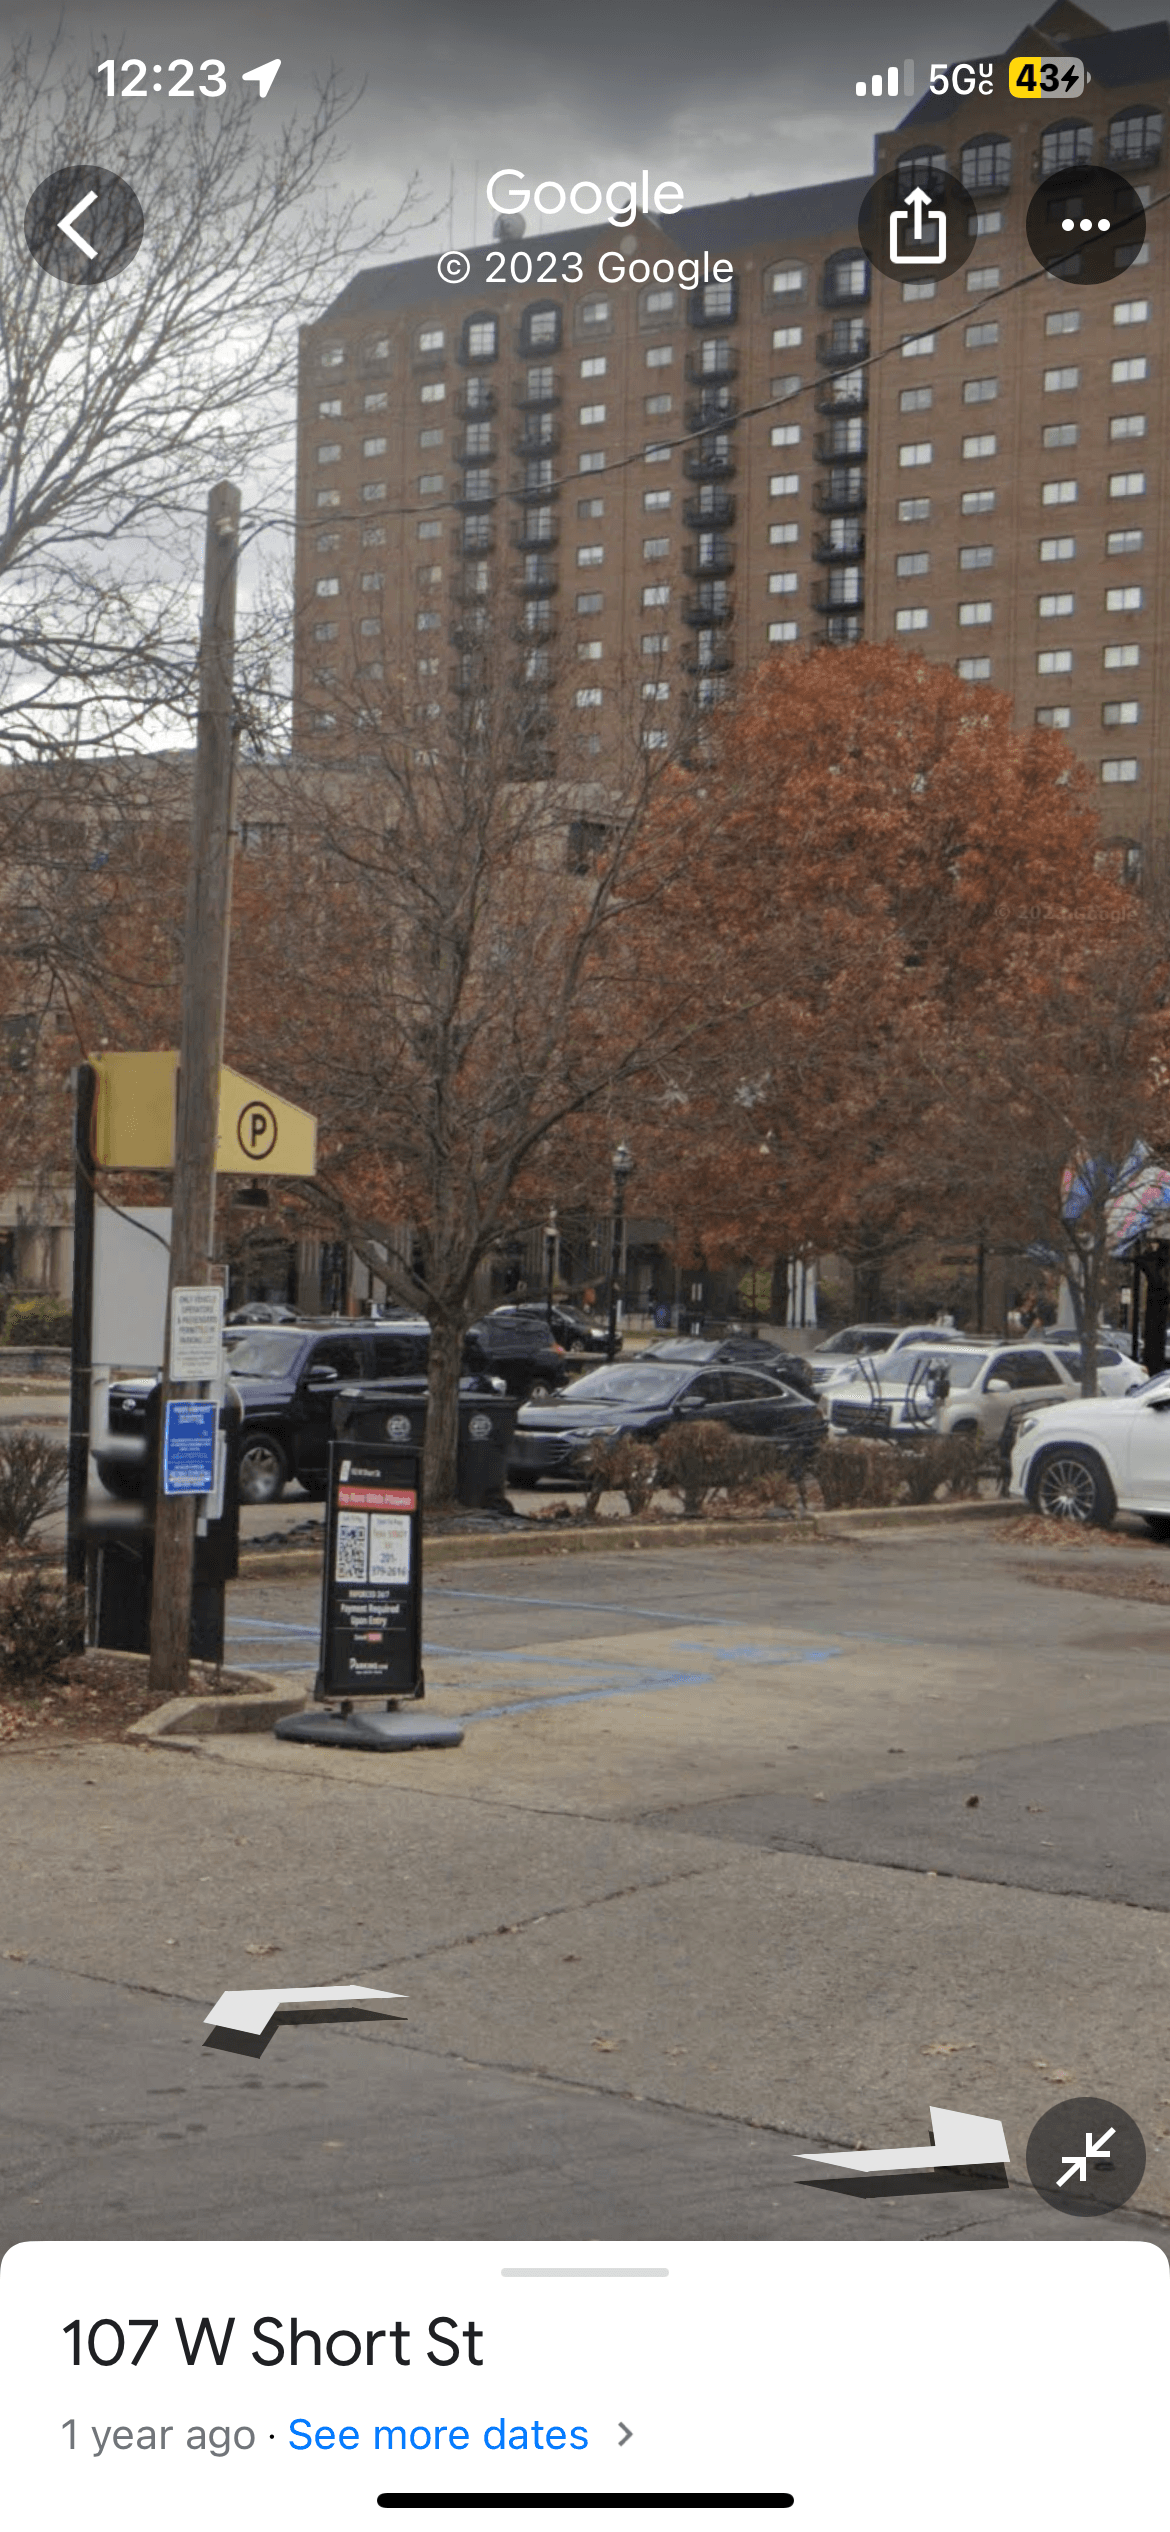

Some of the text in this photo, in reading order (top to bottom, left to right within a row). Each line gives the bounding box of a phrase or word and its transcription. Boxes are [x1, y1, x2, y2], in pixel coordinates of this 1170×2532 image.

[250, 1112, 268, 1148] P
[179, 1295, 217, 1303] ONLY VEHICLE
[181, 1305, 214, 1314] OPERATORS
[182, 1315, 218, 1324] PASSENGERS
[340, 1603, 400, 1615] Payment Required
[350, 1615, 388, 1629] Upon Entry
